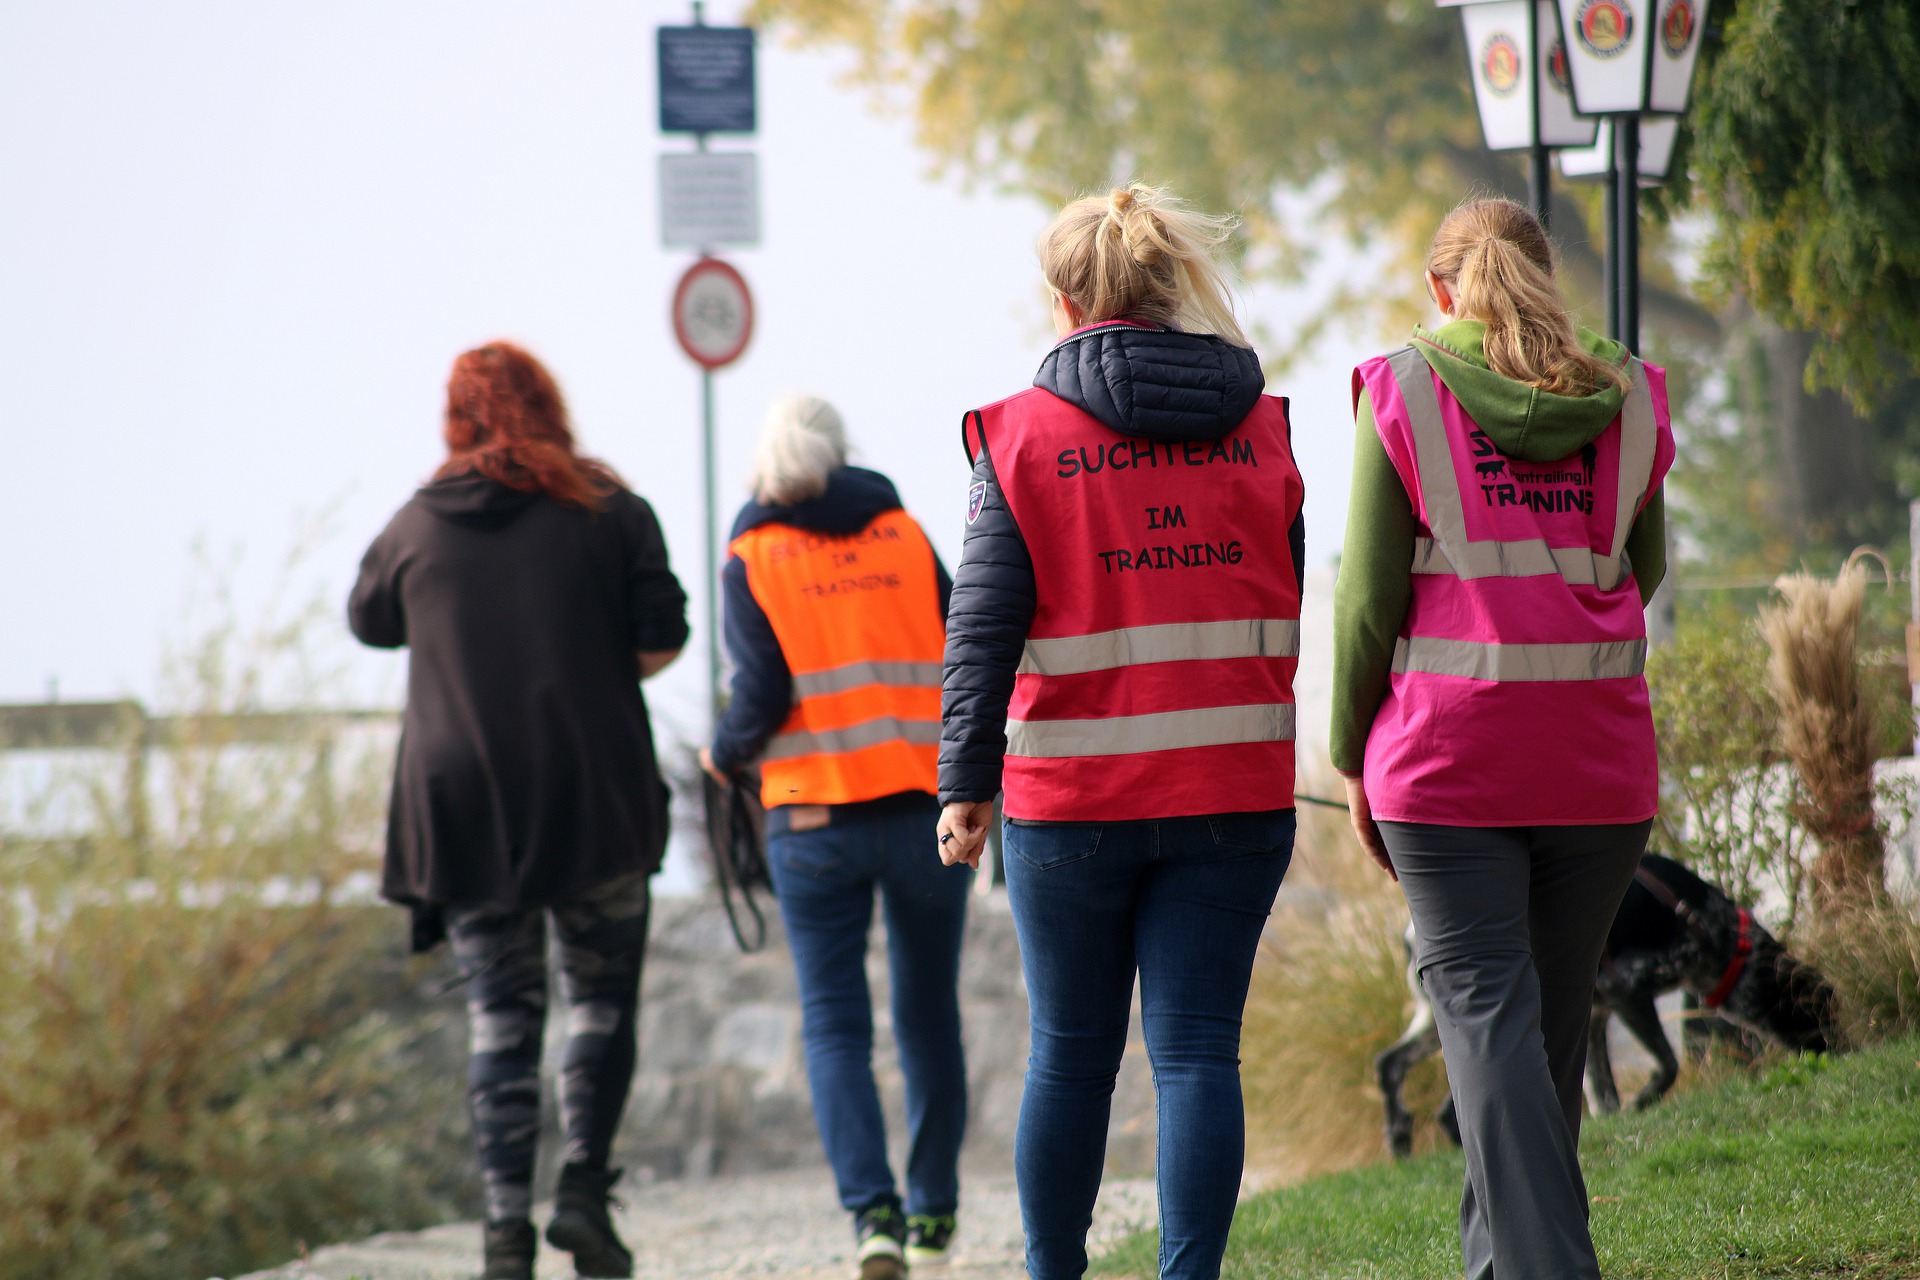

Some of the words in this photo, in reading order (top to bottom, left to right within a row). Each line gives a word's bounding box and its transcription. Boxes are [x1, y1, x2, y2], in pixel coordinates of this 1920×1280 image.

[1057, 437, 1258, 478] SUCHTEAM
[1509, 466, 1582, 486] antrailing
[1145, 505, 1187, 529] IM
[1098, 541, 1243, 574] TRAINING
